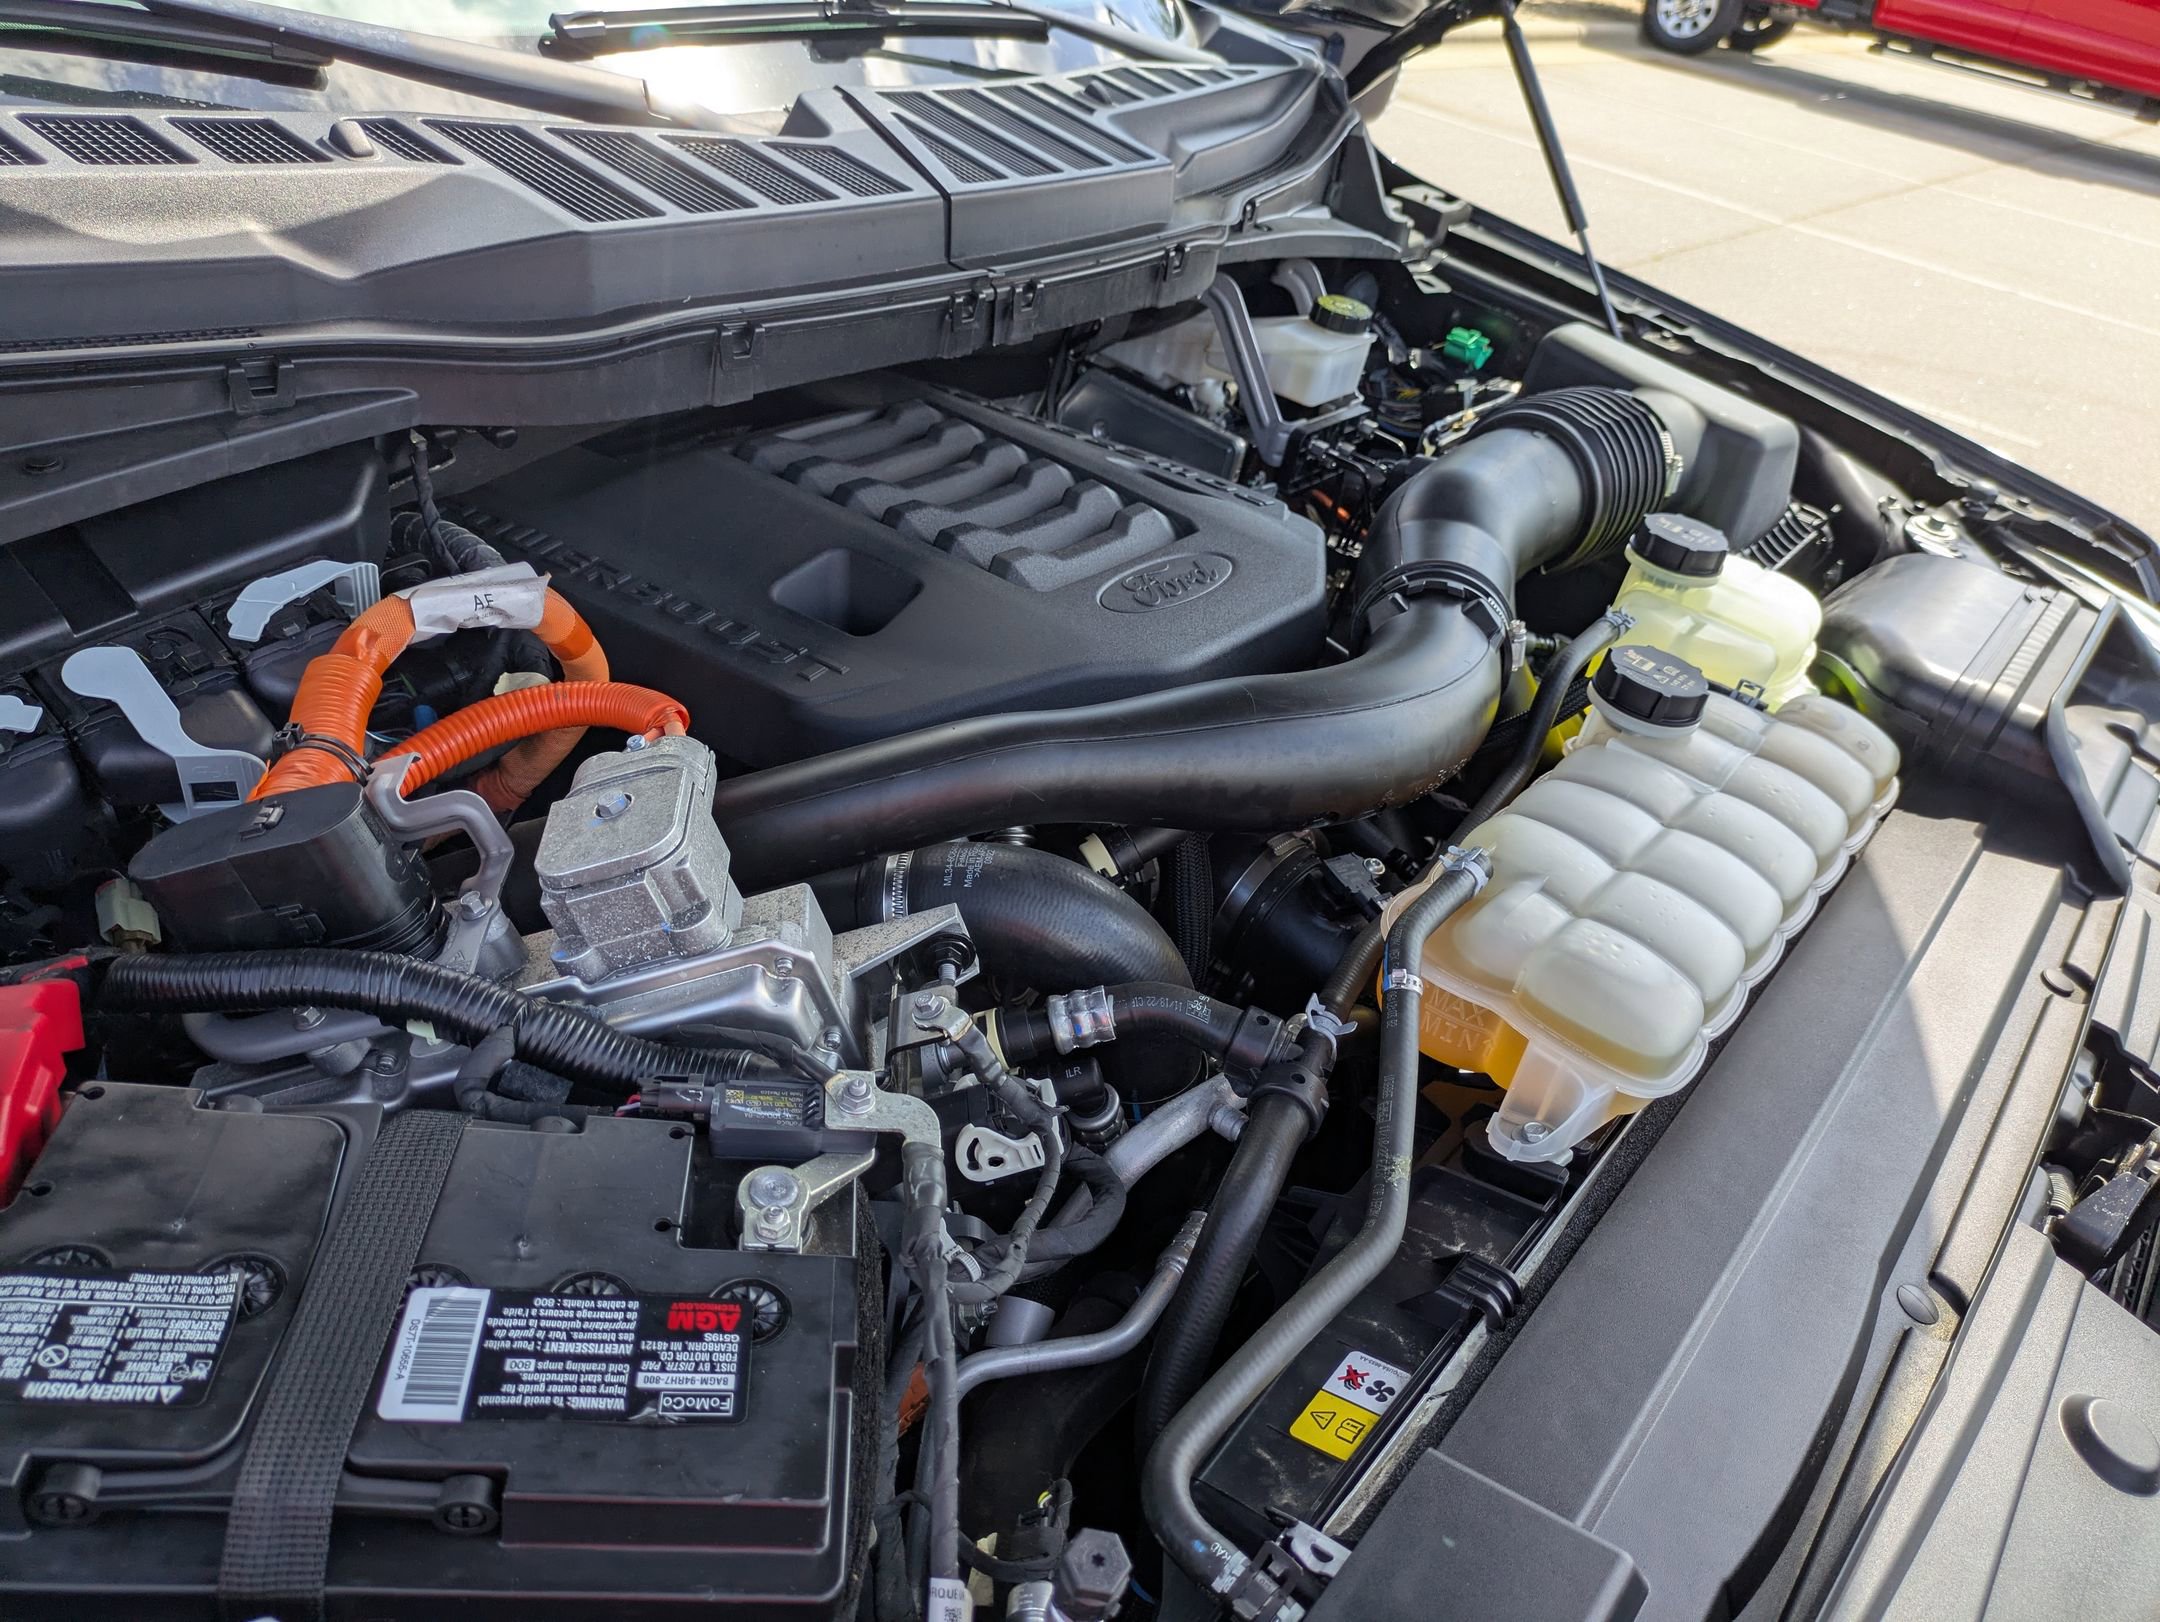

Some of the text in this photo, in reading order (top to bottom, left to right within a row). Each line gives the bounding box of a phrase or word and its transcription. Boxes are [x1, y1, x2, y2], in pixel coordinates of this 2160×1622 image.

[1121, 561, 1218, 607] Ford
[964, 864, 975, 888] Made
[1429, 989, 1487, 1026] MAX
[1422, 1011, 1480, 1051] MIN
[1065, 1066, 1082, 1079] ILR
[128, 1273, 170, 1282] BATTERIE!
[170, 1275, 182, 1283] LA
[182, 1275, 213, 1284] OUVRIR
[213, 1274, 230, 1284] PAS
[118, 1281, 134, 1291] DES
[167, 1283, 178, 1292] LA
[178, 1283, 191, 1292] DE
[191, 1283, 213, 1293] HORS
[213, 1283, 235, 1294] TENIR
[133, 1292, 146, 1302] OF
[146, 1292, 172, 1303] REACH
[172, 1293, 186, 1303] THE
[188, 1294, 202, 1303] OF
[203, 1294, 218, 1304] OUT
[218, 1294, 233, 1304] KEEP
[534, 1298, 555, 1307] 800
[563, 1299, 594, 1308] volants
[596, 1300, 626, 1309] cables
[628, 1301, 639, 1309] de
[670, 1302, 742, 1311] TECHNOLOGY
[191, 1310, 202, 1319] OU
[202, 1310, 229, 1320] BLESSER
[502, 1307, 529, 1317] l'aide
[539, 1308, 574, 1317] secours
[576, 1308, 624, 1319] demarrage
[626, 1312, 637, 1320] de
[169, 1319, 209, 1330] EXPLOSIFS
[208, 1321, 225, 1330] GAZ
[487, 1318, 527, 1327] methode
[529, 1319, 538, 1328] la
[667, 1311, 740, 1332] AGM
[141, 1329, 164, 1339] YEUX
[164, 1329, 178, 1340] LES
[494, 1329, 507, 1338] du
[508, 1328, 535, 1338] guide
[548, 1331, 567, 1340] Voir
[570, 1331, 616, 1341] blessures.
[618, 1333, 634, 1341] des
[704, 1333, 739, 1341] G519S
[130, 1341, 216, 1352] BLINDNESS OR INJURY
[513, 1340, 535, 1350] Pour
[544, 1342, 633, 1355] AVERTISSEMENT
[641, 1341, 668, 1349] 48121
[685, 1341, 738, 1351] DEARBORN,
[144, 1351, 159, 1360] CAN
[159, 1351, 186, 1361] GASES
[676, 1352, 710, 1360] MOTOR
[712, 1353, 738, 1361] FORD
[125, 1361, 172, 1372] EXPLOSIVE
[510, 1360, 630, 1373] Cold cranking amps 800
[641, 1361, 736, 1372] DIST. BY DISTR. PAR
[112, 1371, 137, 1381] EYES
[519, 1373, 628, 1383] jump start instructions.
[22, 1382, 158, 1401] DANGER/POISON
[501, 1383, 627, 1395] injury see owner guide for
[478, 1394, 625, 1410] WARNING: To avoid personal
[663, 1396, 731, 1410] FoMoCo
